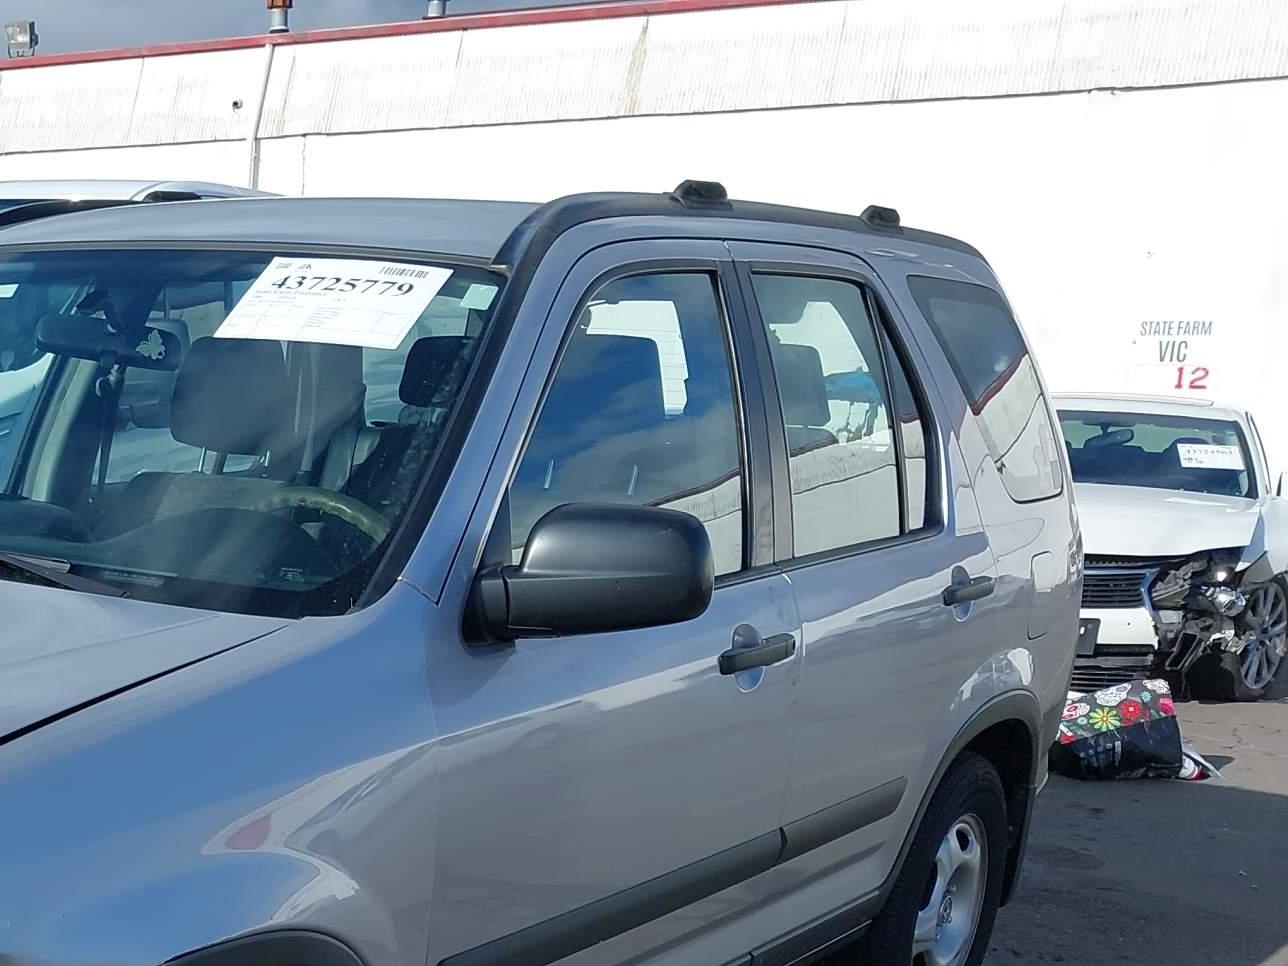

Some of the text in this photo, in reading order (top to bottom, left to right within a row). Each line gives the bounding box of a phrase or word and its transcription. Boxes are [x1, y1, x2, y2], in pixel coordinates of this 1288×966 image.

[271, 274, 414, 297] 43725779
[1140, 320, 1212, 336] STATE FARM
[1159, 340, 1188, 362] VIC
[1175, 366, 1209, 389] 12
